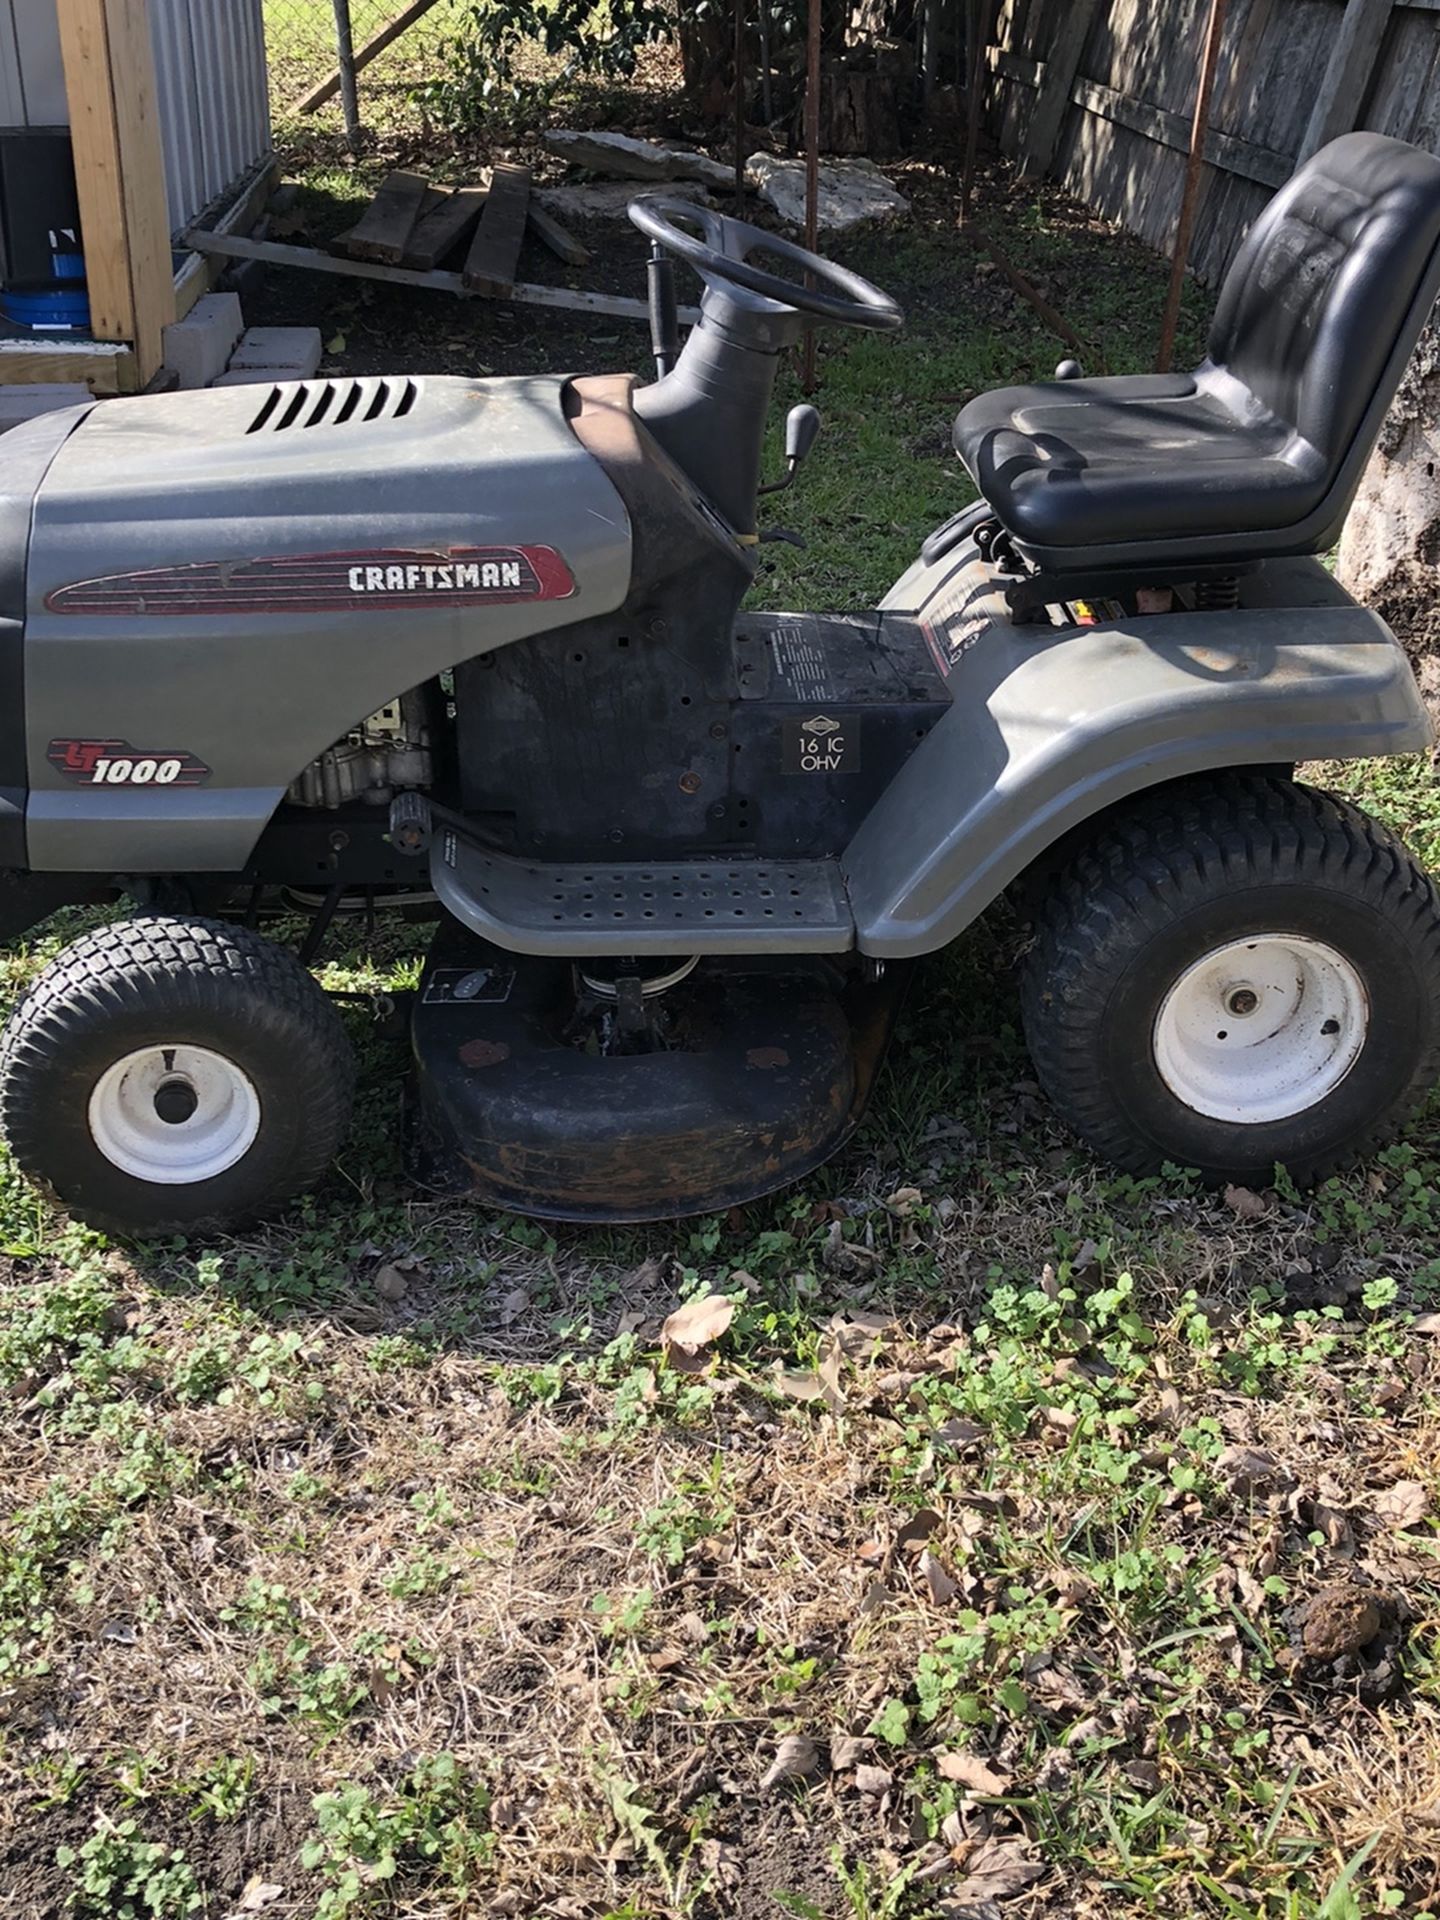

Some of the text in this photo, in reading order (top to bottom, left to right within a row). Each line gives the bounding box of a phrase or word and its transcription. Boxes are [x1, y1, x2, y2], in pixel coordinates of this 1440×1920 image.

[348, 562, 521, 591] CRAFTSMAN
[799, 737, 844, 753] 16 IC
[65, 742, 182, 784] LT 1000
[801, 755, 841, 771] OHV
